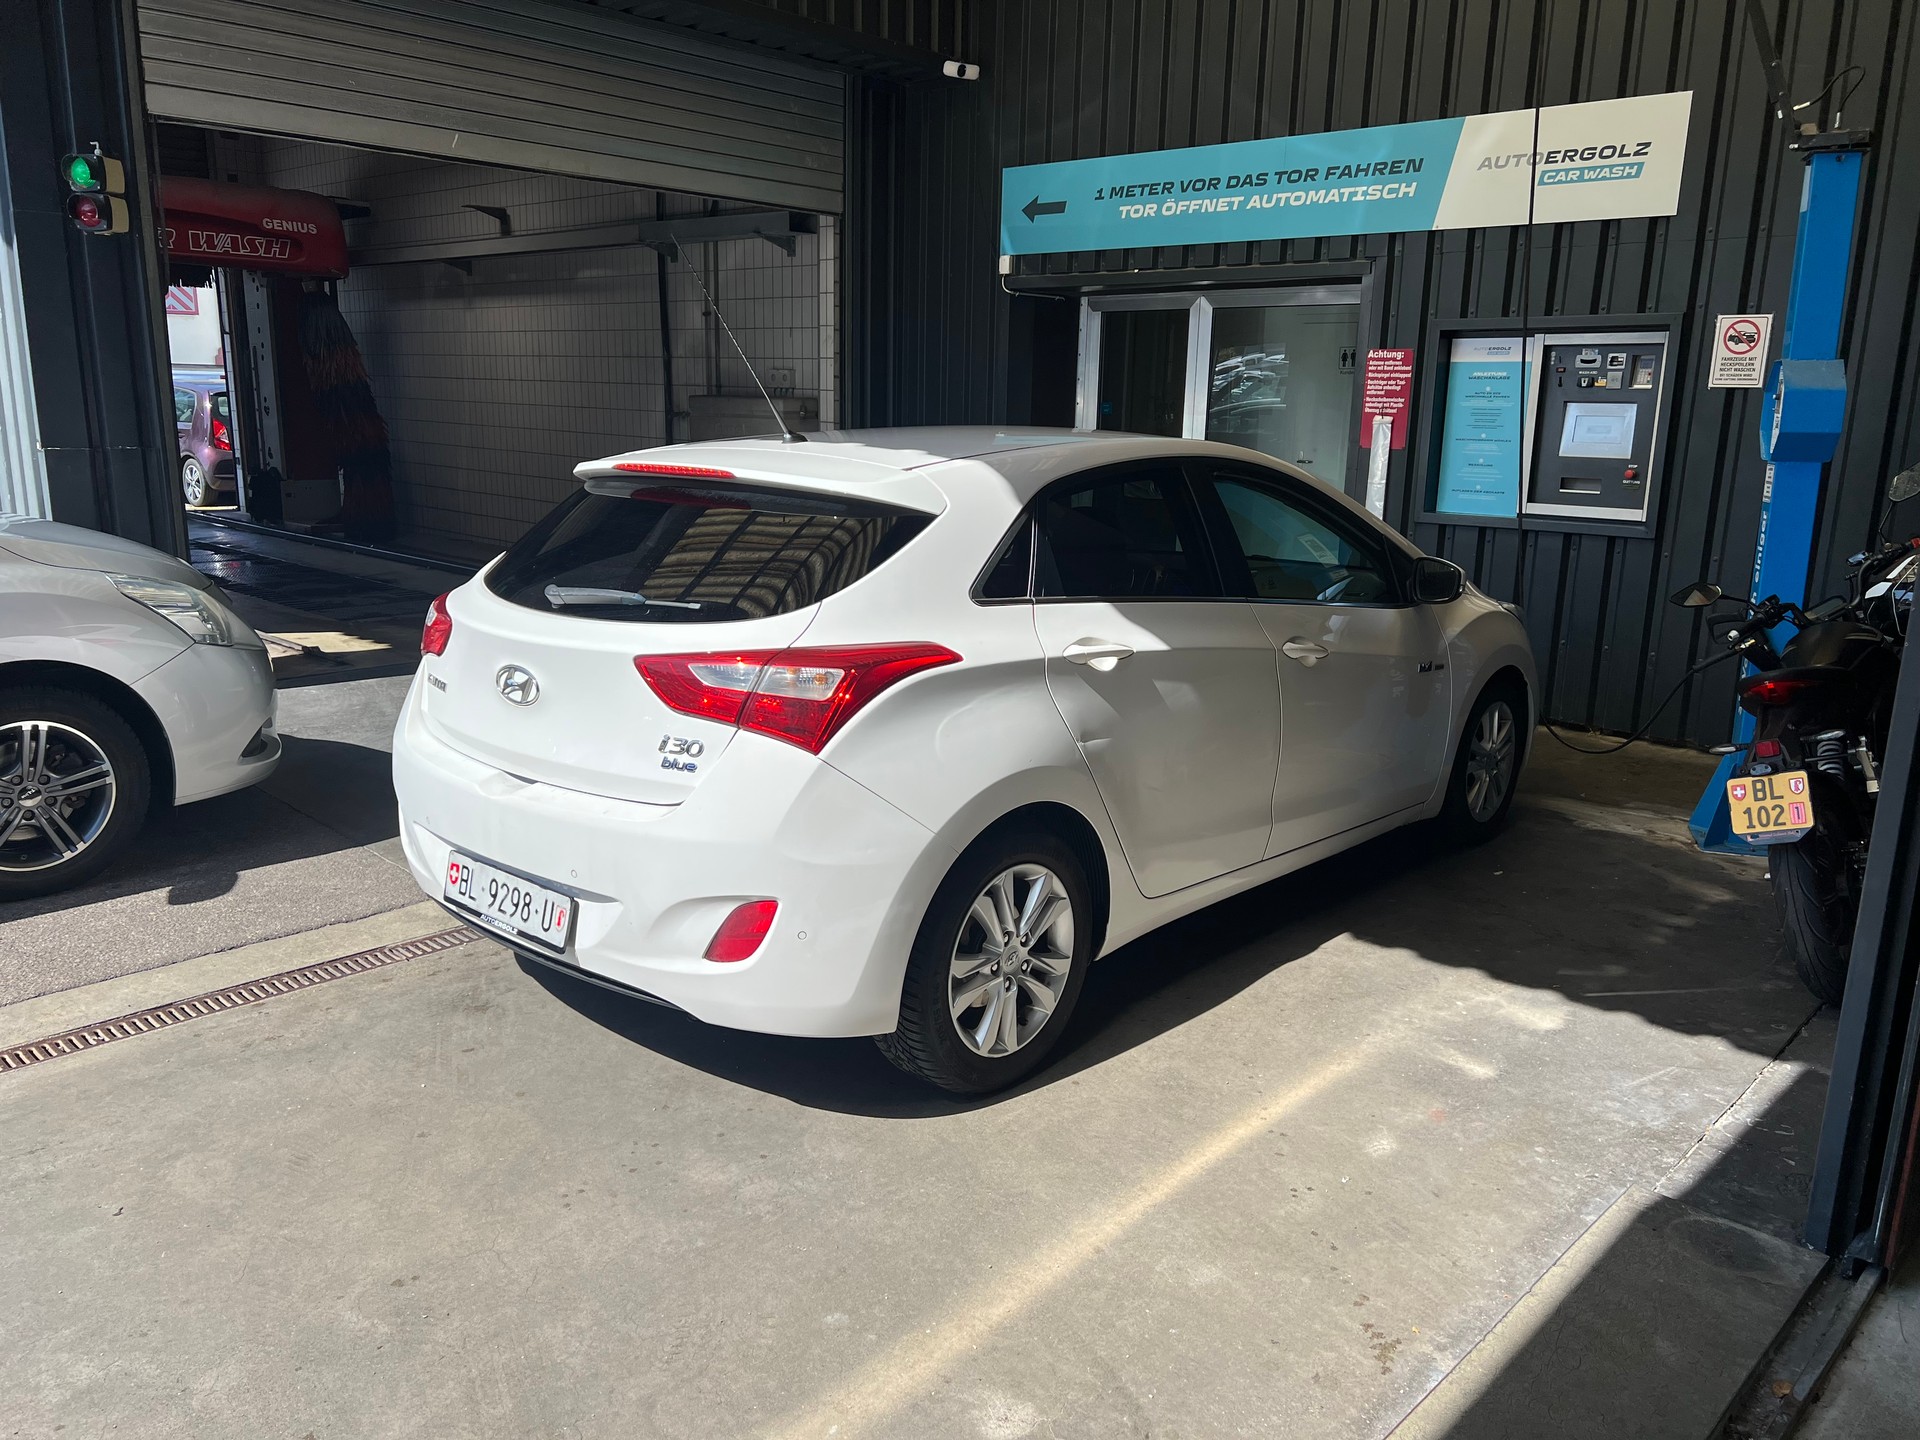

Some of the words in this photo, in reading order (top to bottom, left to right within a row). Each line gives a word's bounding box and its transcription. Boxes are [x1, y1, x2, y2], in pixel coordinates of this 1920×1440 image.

[1477, 142, 1652, 171] AUTOERGOLZ
[1095, 188, 1105, 200] 1
[1109, 181, 1175, 199] METER
[1180, 177, 1221, 193] VOR
[1226, 172, 1269, 189] DAS
[1274, 168, 1319, 185] TOR
[1324, 158, 1424, 180] FAHREN
[1543, 171, 1578, 183] CAR
[1583, 165, 1638, 180] WASH
[1119, 203, 1158, 219] TOR
[1162, 196, 1244, 216] ÖFFNET
[1246, 182, 1417, 209] AUTOMATISCH
[262, 217, 318, 235] GENIUS
[189, 230, 291, 259] WASH
[1368, 350, 1405, 360] Achtung:
[658, 734, 704, 758] i30
[661, 756, 698, 773] blue
[1752, 778, 1784, 802] BL
[1743, 804, 1787, 829] 102
[459, 865, 477, 902] BL
[488, 878, 532, 923] 9298
[480, 914, 519, 935] AUTOERGOLZ
